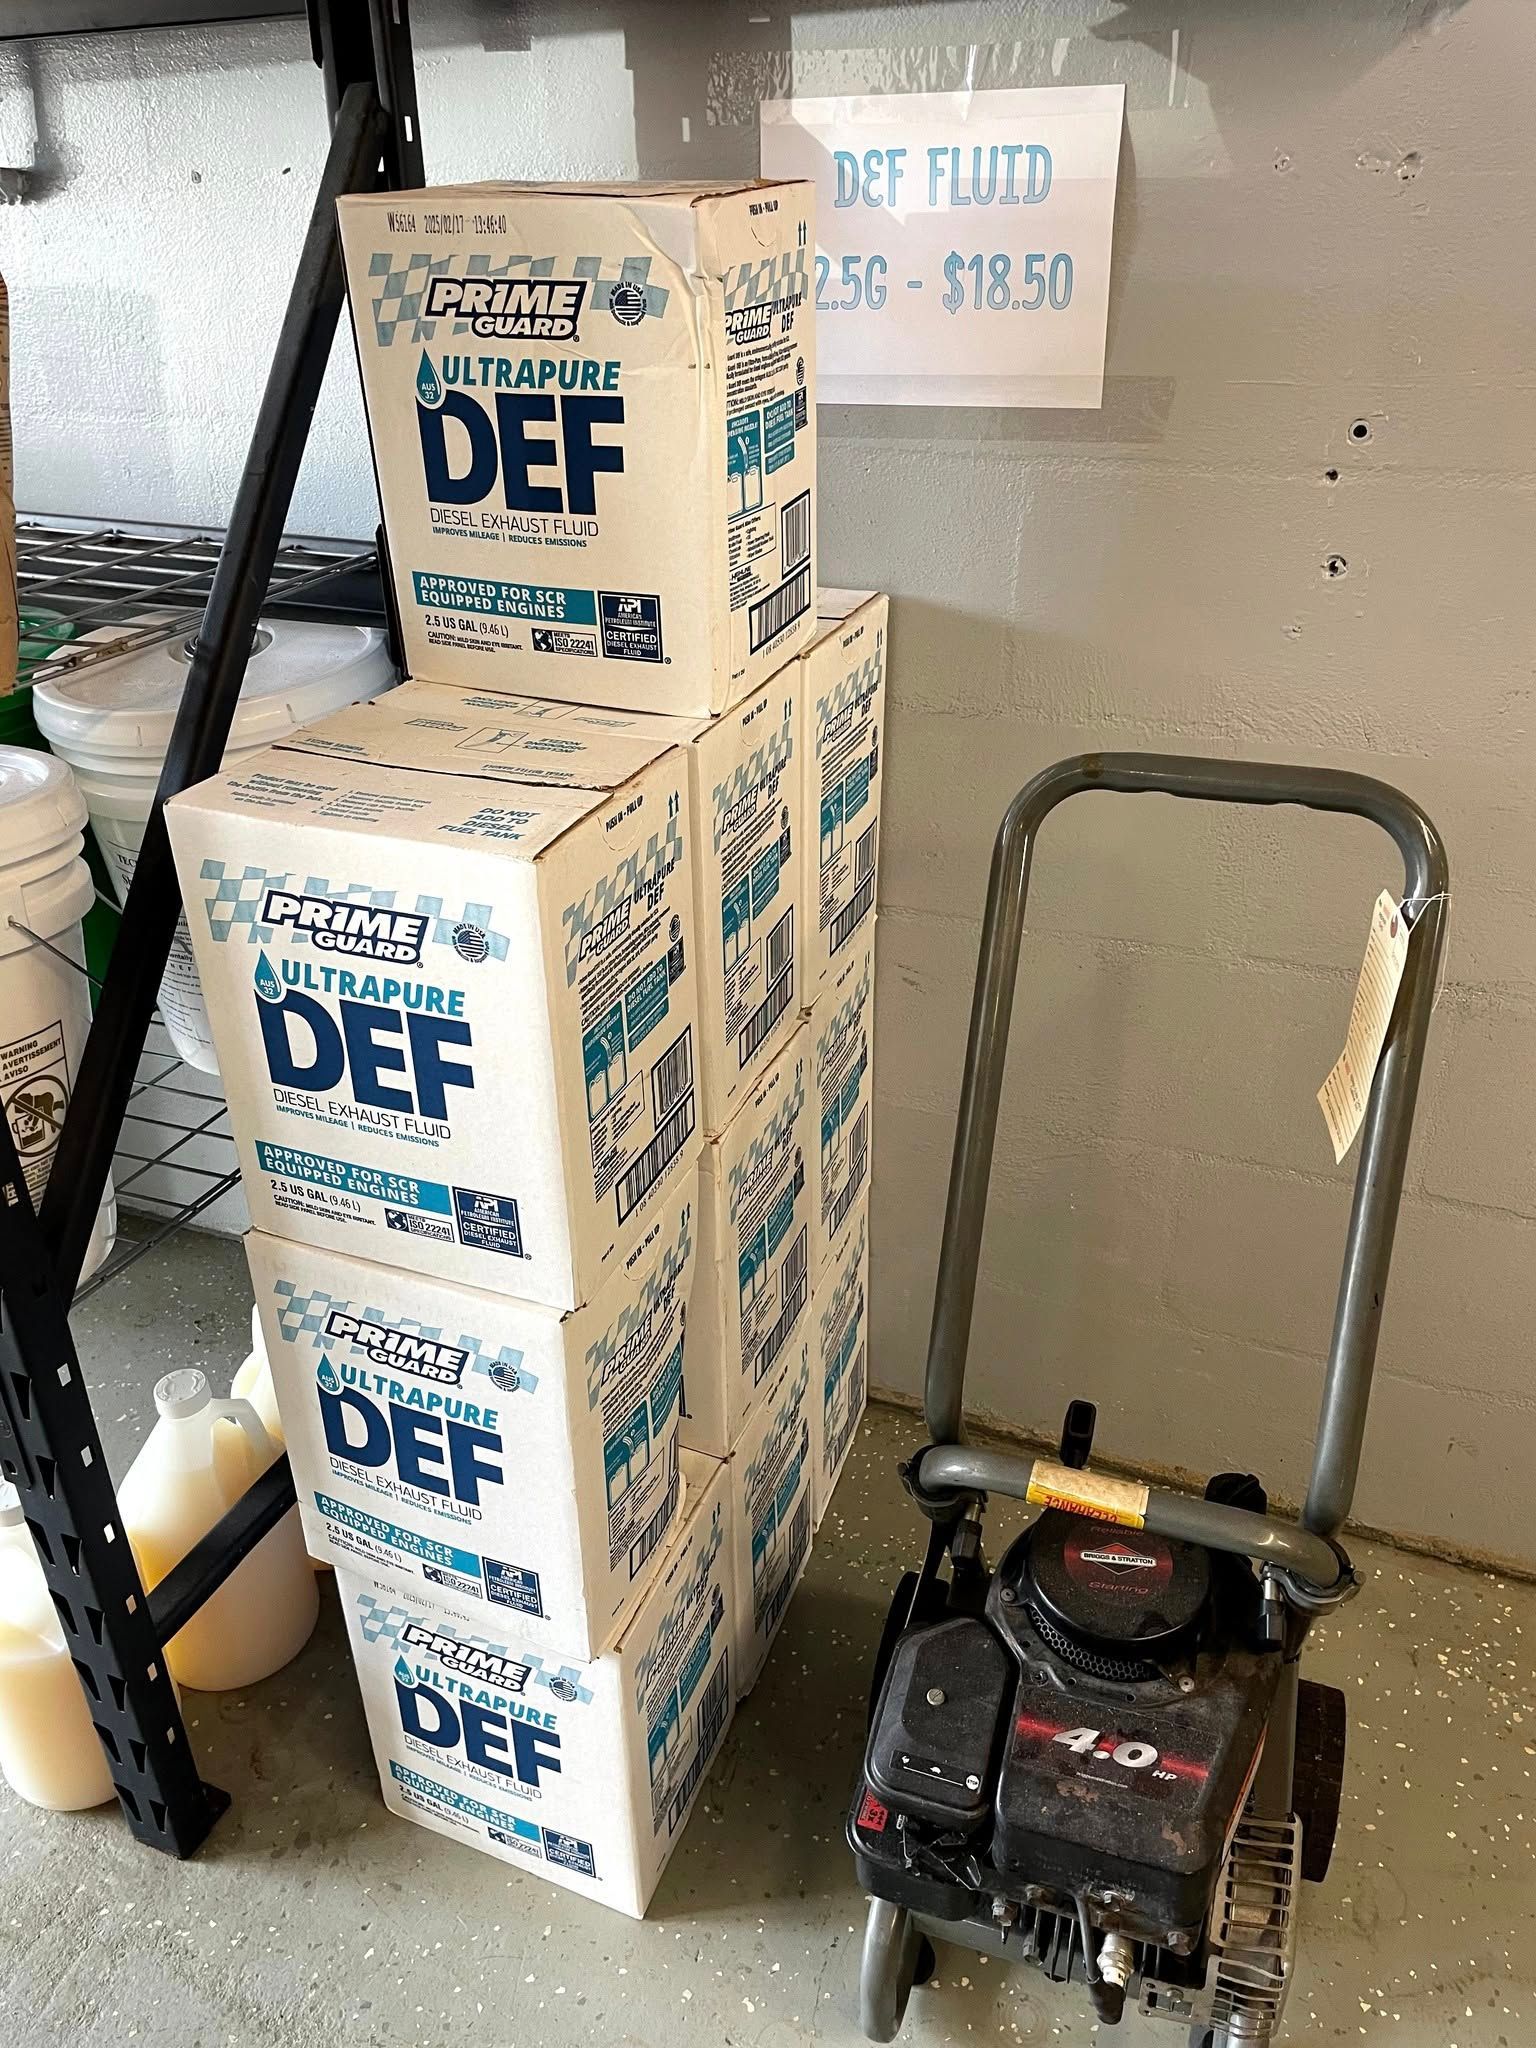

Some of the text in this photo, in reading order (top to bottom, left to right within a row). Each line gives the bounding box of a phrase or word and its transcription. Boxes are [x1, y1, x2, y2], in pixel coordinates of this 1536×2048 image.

[833, 145, 1053, 208] DEF FLUID
[427, 279, 586, 316] PRIME
[815, 255, 887, 311] 2.5G
[942, 250, 1074, 315] $18.50
[473, 319, 576, 338] GUARD
[735, 325, 770, 344] GUARD
[781, 311, 794, 333] DEF
[421, 383, 436, 392] AUS
[442, 355, 621, 391] ULTRAPURE
[424, 392, 435, 400] 32
[416, 389, 625, 515] DEF
[430, 507, 599, 537] DIESEL EXHAUST FLUID
[432, 527, 587, 548] IMPROVES MILEAGE REDUCES EMISSIONS
[420, 576, 566, 605] APPROVED FOR SCR
[422, 590, 565, 619] EQUIPPED ENGINES
[425, 615, 440, 627] 2.5
[442, 616, 456, 629] US
[458, 618, 478, 632] GAL
[606, 630, 656, 643] CERTIFIED
[555, 637, 593, 650] ISO 22241
[607, 640, 657, 651] DIESEL EXHAUST
[462, 820, 515, 832] DIESEL
[479, 807, 541, 818] DO NOT
[438, 825, 526, 840] FUEL TANK
[634, 857, 675, 904] ULTRAPURE
[647, 882, 665, 912] DEF
[264, 892, 427, 946] PRIME
[580, 896, 632, 961] PRIME
[314, 931, 419, 963] GUARD
[595, 918, 630, 955] GUARD
[259, 979, 276, 988] AUS
[263, 987, 275, 996] 32
[282, 959, 466, 1018] ULTRAPURE
[0, 1040, 38, 1060] WARNING
[2, 1037, 61, 1070] AVERTISSEMENT
[253, 989, 475, 1122] DEF
[4, 1065, 29, 1081] AVISO
[273, 1088, 451, 1140] DIESEL EXHAUST FLUID
[276, 1105, 439, 1147] IMPROVES MILEAGE REDUCES EMISSIONS
[264, 1145, 420, 1194] APPROVED FOR SCR
[266, 1158, 419, 1205] EQUIPPED ENGINES
[271, 1180, 287, 1192] 2.5
[289, 1184, 304, 1196] US
[307, 1189, 328, 1203] GAL
[329, 1195, 351, 1209] (9.46
[410, 1220, 450, 1236] ISO 22241
[463, 1221, 516, 1240] CERTIFIED
[464, 1231, 517, 1246] DIESEL EXHAUST
[481, 1240, 500, 1249] FLUID
[327, 1312, 467, 1373] PRIME
[601, 1311, 652, 1387] PRIME
[368, 1347, 459, 1384] GUARD
[340, 1364, 498, 1430] ULTRAPURE
[316, 1381, 504, 1506] DEF
[330, 1456, 482, 1521] DIESEL EXHAUST FLUID
[321, 1496, 454, 1557] APPROVED FOR SCR
[323, 1508, 386, 1540] EQUIPPED
[391, 1534, 453, 1566] ENGINES
[326, 1522, 340, 1534] 2.5
[342, 1529, 354, 1541] US
[356, 1536, 374, 1550] GAL
[1084, 1553, 1110, 1561] BRIGGS
[1117, 1556, 1153, 1565] STRATTON
[490, 1585, 537, 1604] CERTIFIED
[403, 1625, 530, 1679] PRIME
[441, 1656, 523, 1691] GUARD
[416, 1665, 558, 1730] ULTRAPURE
[394, 1674, 562, 1788] DEF
[1052, 1727, 1158, 1768] 4.0
[404, 1734, 443, 1760] DIESEL
[447, 1754, 501, 1784] EXHAUST
[506, 1781, 542, 1799] FLUID
[1151, 1770, 1178, 1780] HP
[395, 1765, 458, 1800] APPROVED
[463, 1797, 487, 1814] FOR
[491, 1809, 516, 1825] SCR
[397, 1774, 454, 1804] EQUIPPED
[461, 1803, 515, 1831] ENGINES
